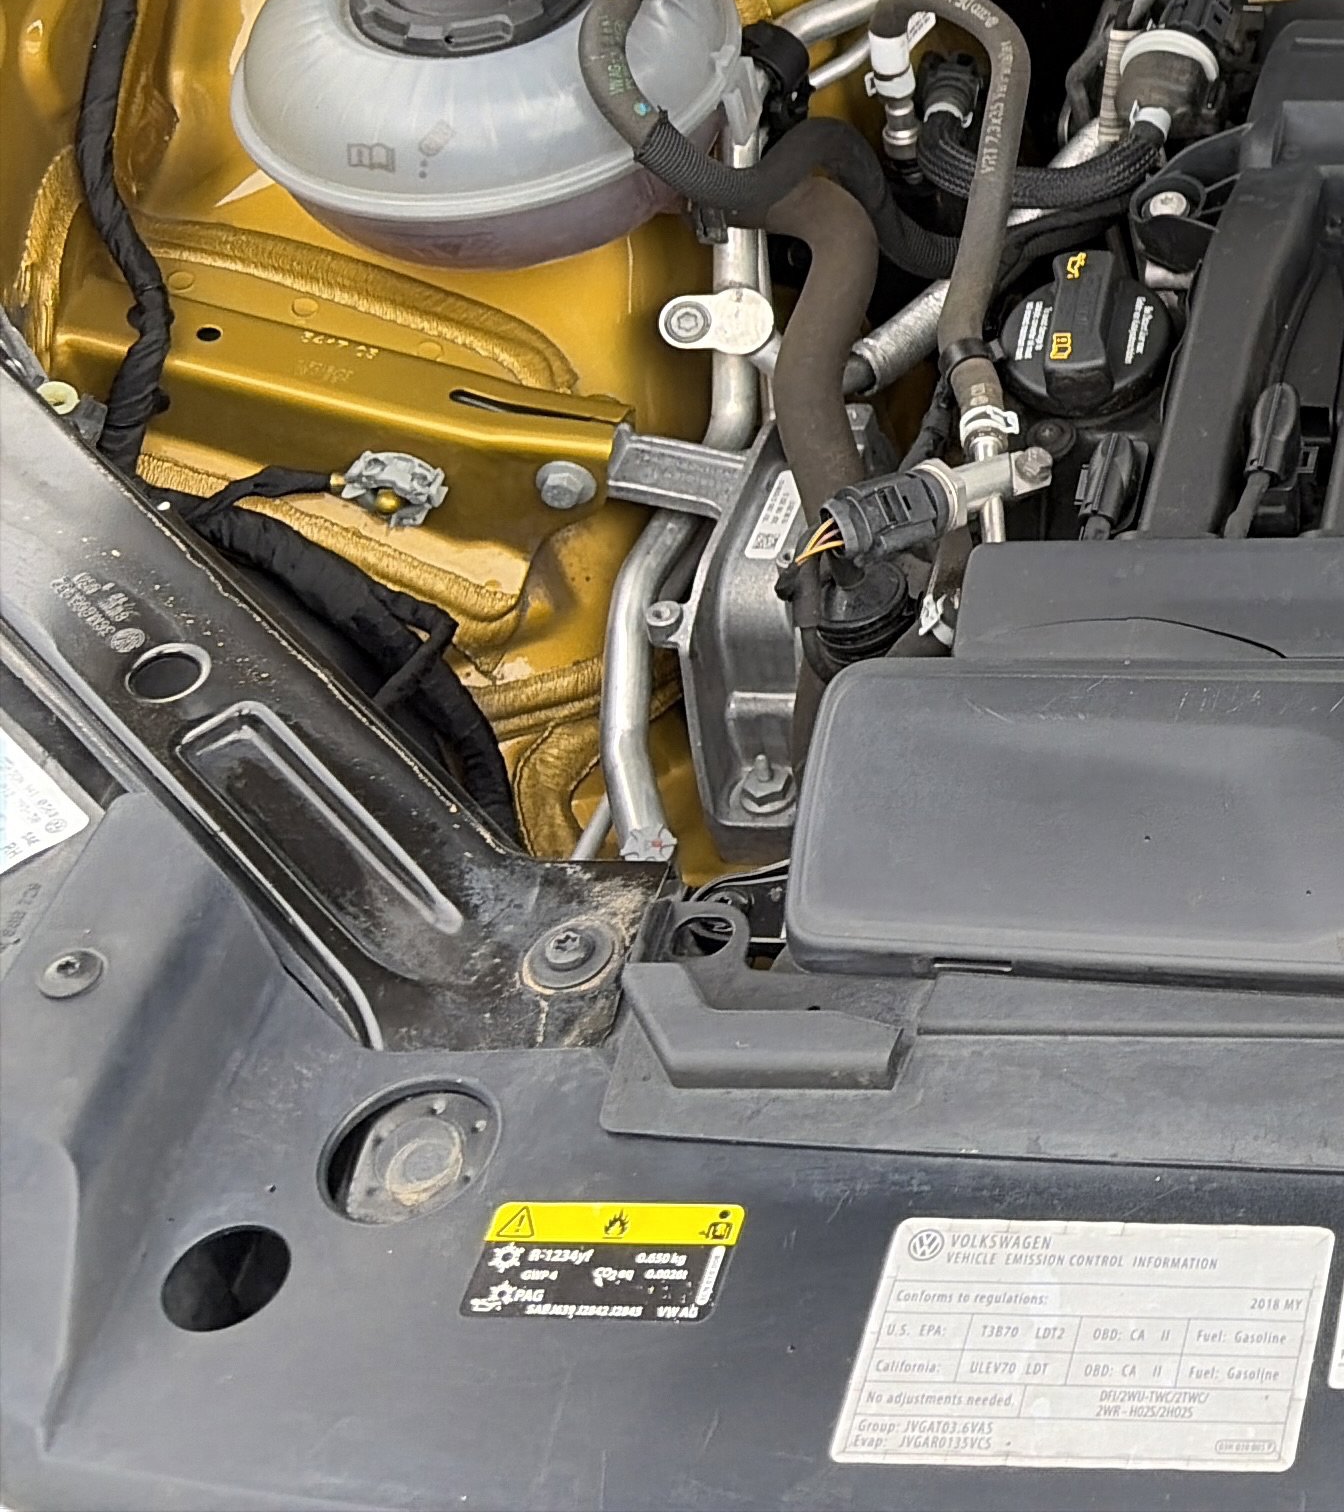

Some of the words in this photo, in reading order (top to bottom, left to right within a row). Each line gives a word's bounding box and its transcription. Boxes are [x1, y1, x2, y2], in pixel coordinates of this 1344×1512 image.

[951, 1233, 1051, 1250] VOLKSWAGEN
[527, 1248, 595, 1266] R-1234yf
[670, 1252, 688, 1267] kg
[946, 1252, 997, 1265] VEHICLE
[1005, 1253, 1065, 1266] EMISSION
[1069, 1254, 1124, 1267] CONTROL
[1132, 1255, 1218, 1270] INFORMATION
[513, 1289, 545, 1302] PAG
[896, 1289, 953, 1303] Conforms
[958, 1291, 970, 1303] to
[974, 1292, 1048, 1307] regulations:
[1249, 1298, 1280, 1310] 2018
[1283, 1299, 1303, 1311] MY
[886, 1324, 911, 1336] U.S.
[919, 1324, 947, 1337] EPA:
[981, 1325, 1020, 1338] T3B70
[1035, 1327, 1066, 1340] LDT2
[1092, 1328, 1123, 1341] OBD:
[1130, 1328, 1145, 1341] CA
[1161, 1329, 1171, 1341] II
[1196, 1330, 1228, 1343] Fuel:
[1234, 1330, 1287, 1344] Gasoline
[875, 1359, 941, 1374] California:
[969, 1361, 1017, 1374] ULEV70
[1025, 1363, 1049, 1375] LDT
[1084, 1364, 1114, 1377] OBD:
[1121, 1364, 1137, 1377] CA
[1152, 1365, 1162, 1377] II
[1188, 1366, 1219, 1380] Fuel:
[1226, 1367, 1280, 1381] Gasoline
[866, 1391, 882, 1404] No
[886, 1391, 963, 1408] adjustments
[967, 1393, 1014, 1407] needed.
[858, 1419, 900, 1434] Group:
[852, 1436, 887, 1449] Evap:
